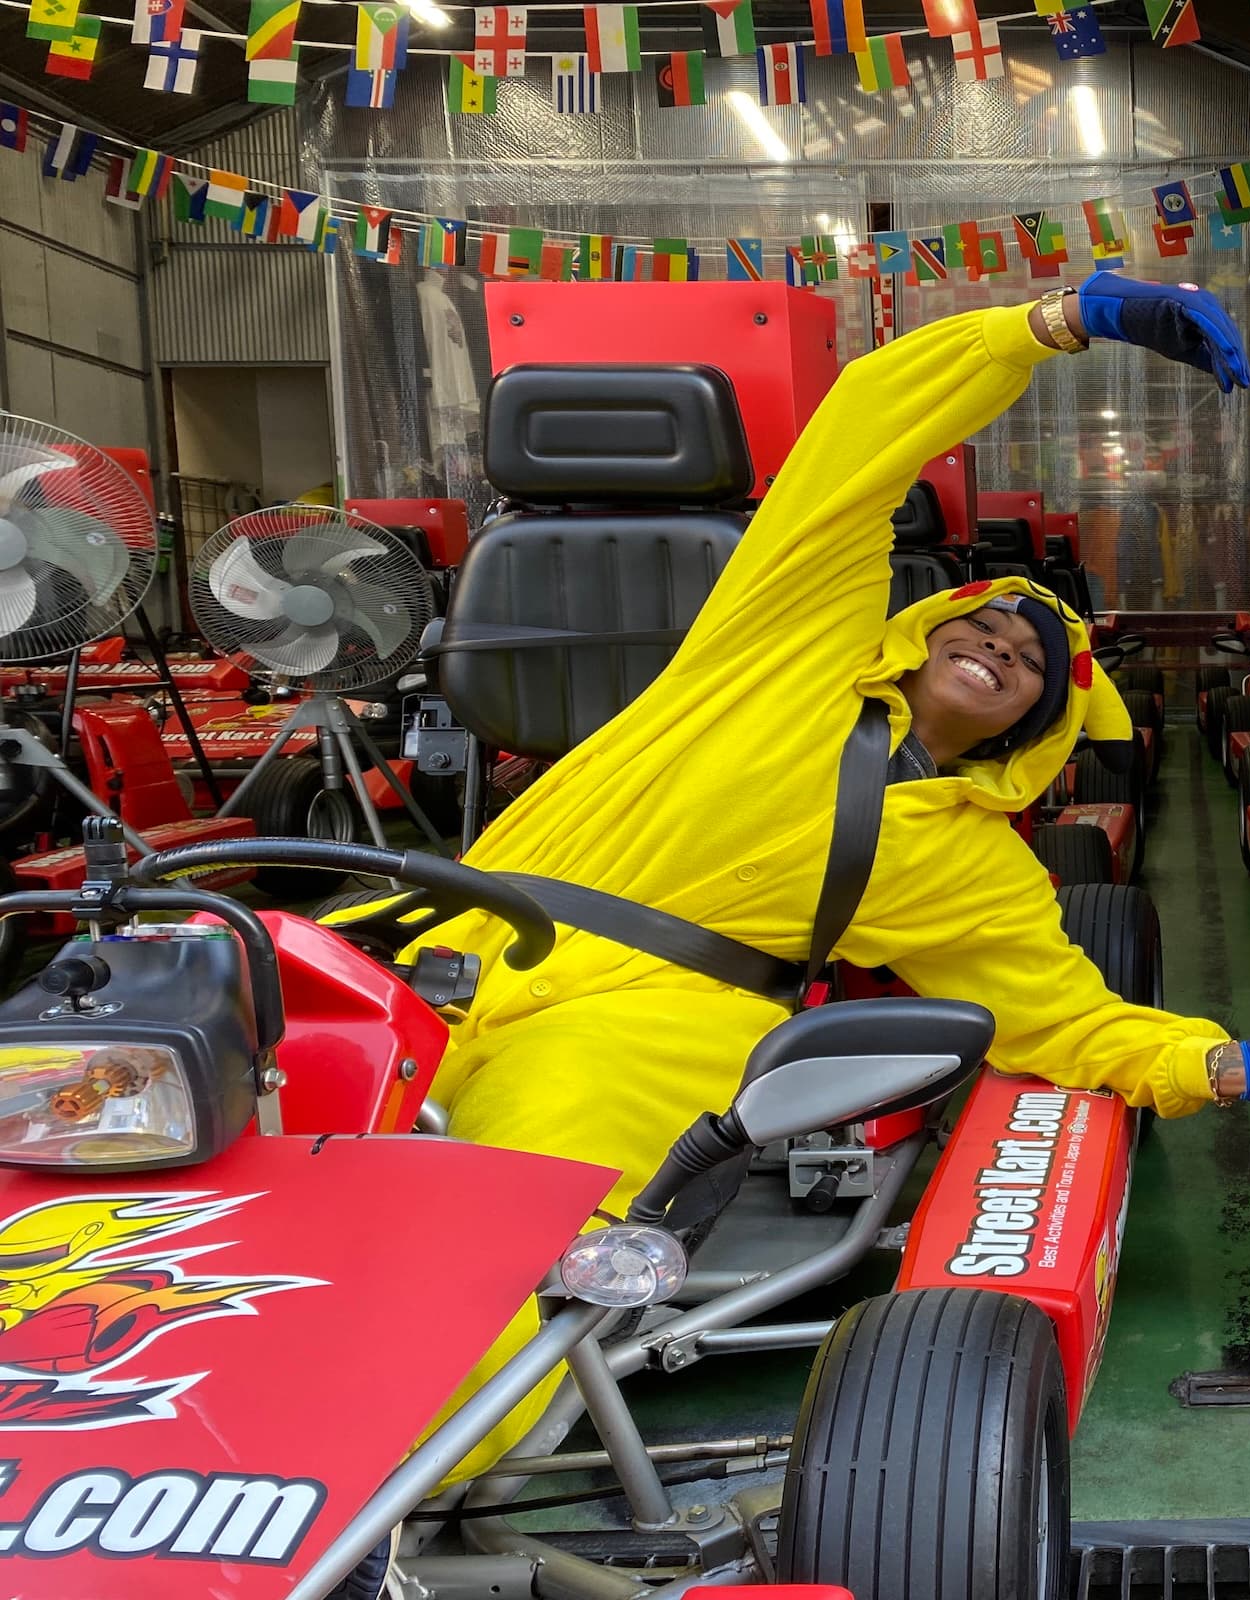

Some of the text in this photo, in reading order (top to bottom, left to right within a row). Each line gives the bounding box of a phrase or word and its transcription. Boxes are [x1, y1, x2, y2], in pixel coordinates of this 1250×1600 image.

[1064, 1142, 1081, 1161] Japan
[950, 1093, 1067, 1276] Street Kart.com
[1056, 1168, 1074, 1190] Tours
[1057, 1188, 1070, 1203] and
[1044, 1202, 1068, 1245] Activities
[1038, 1247, 1058, 1268] Best
